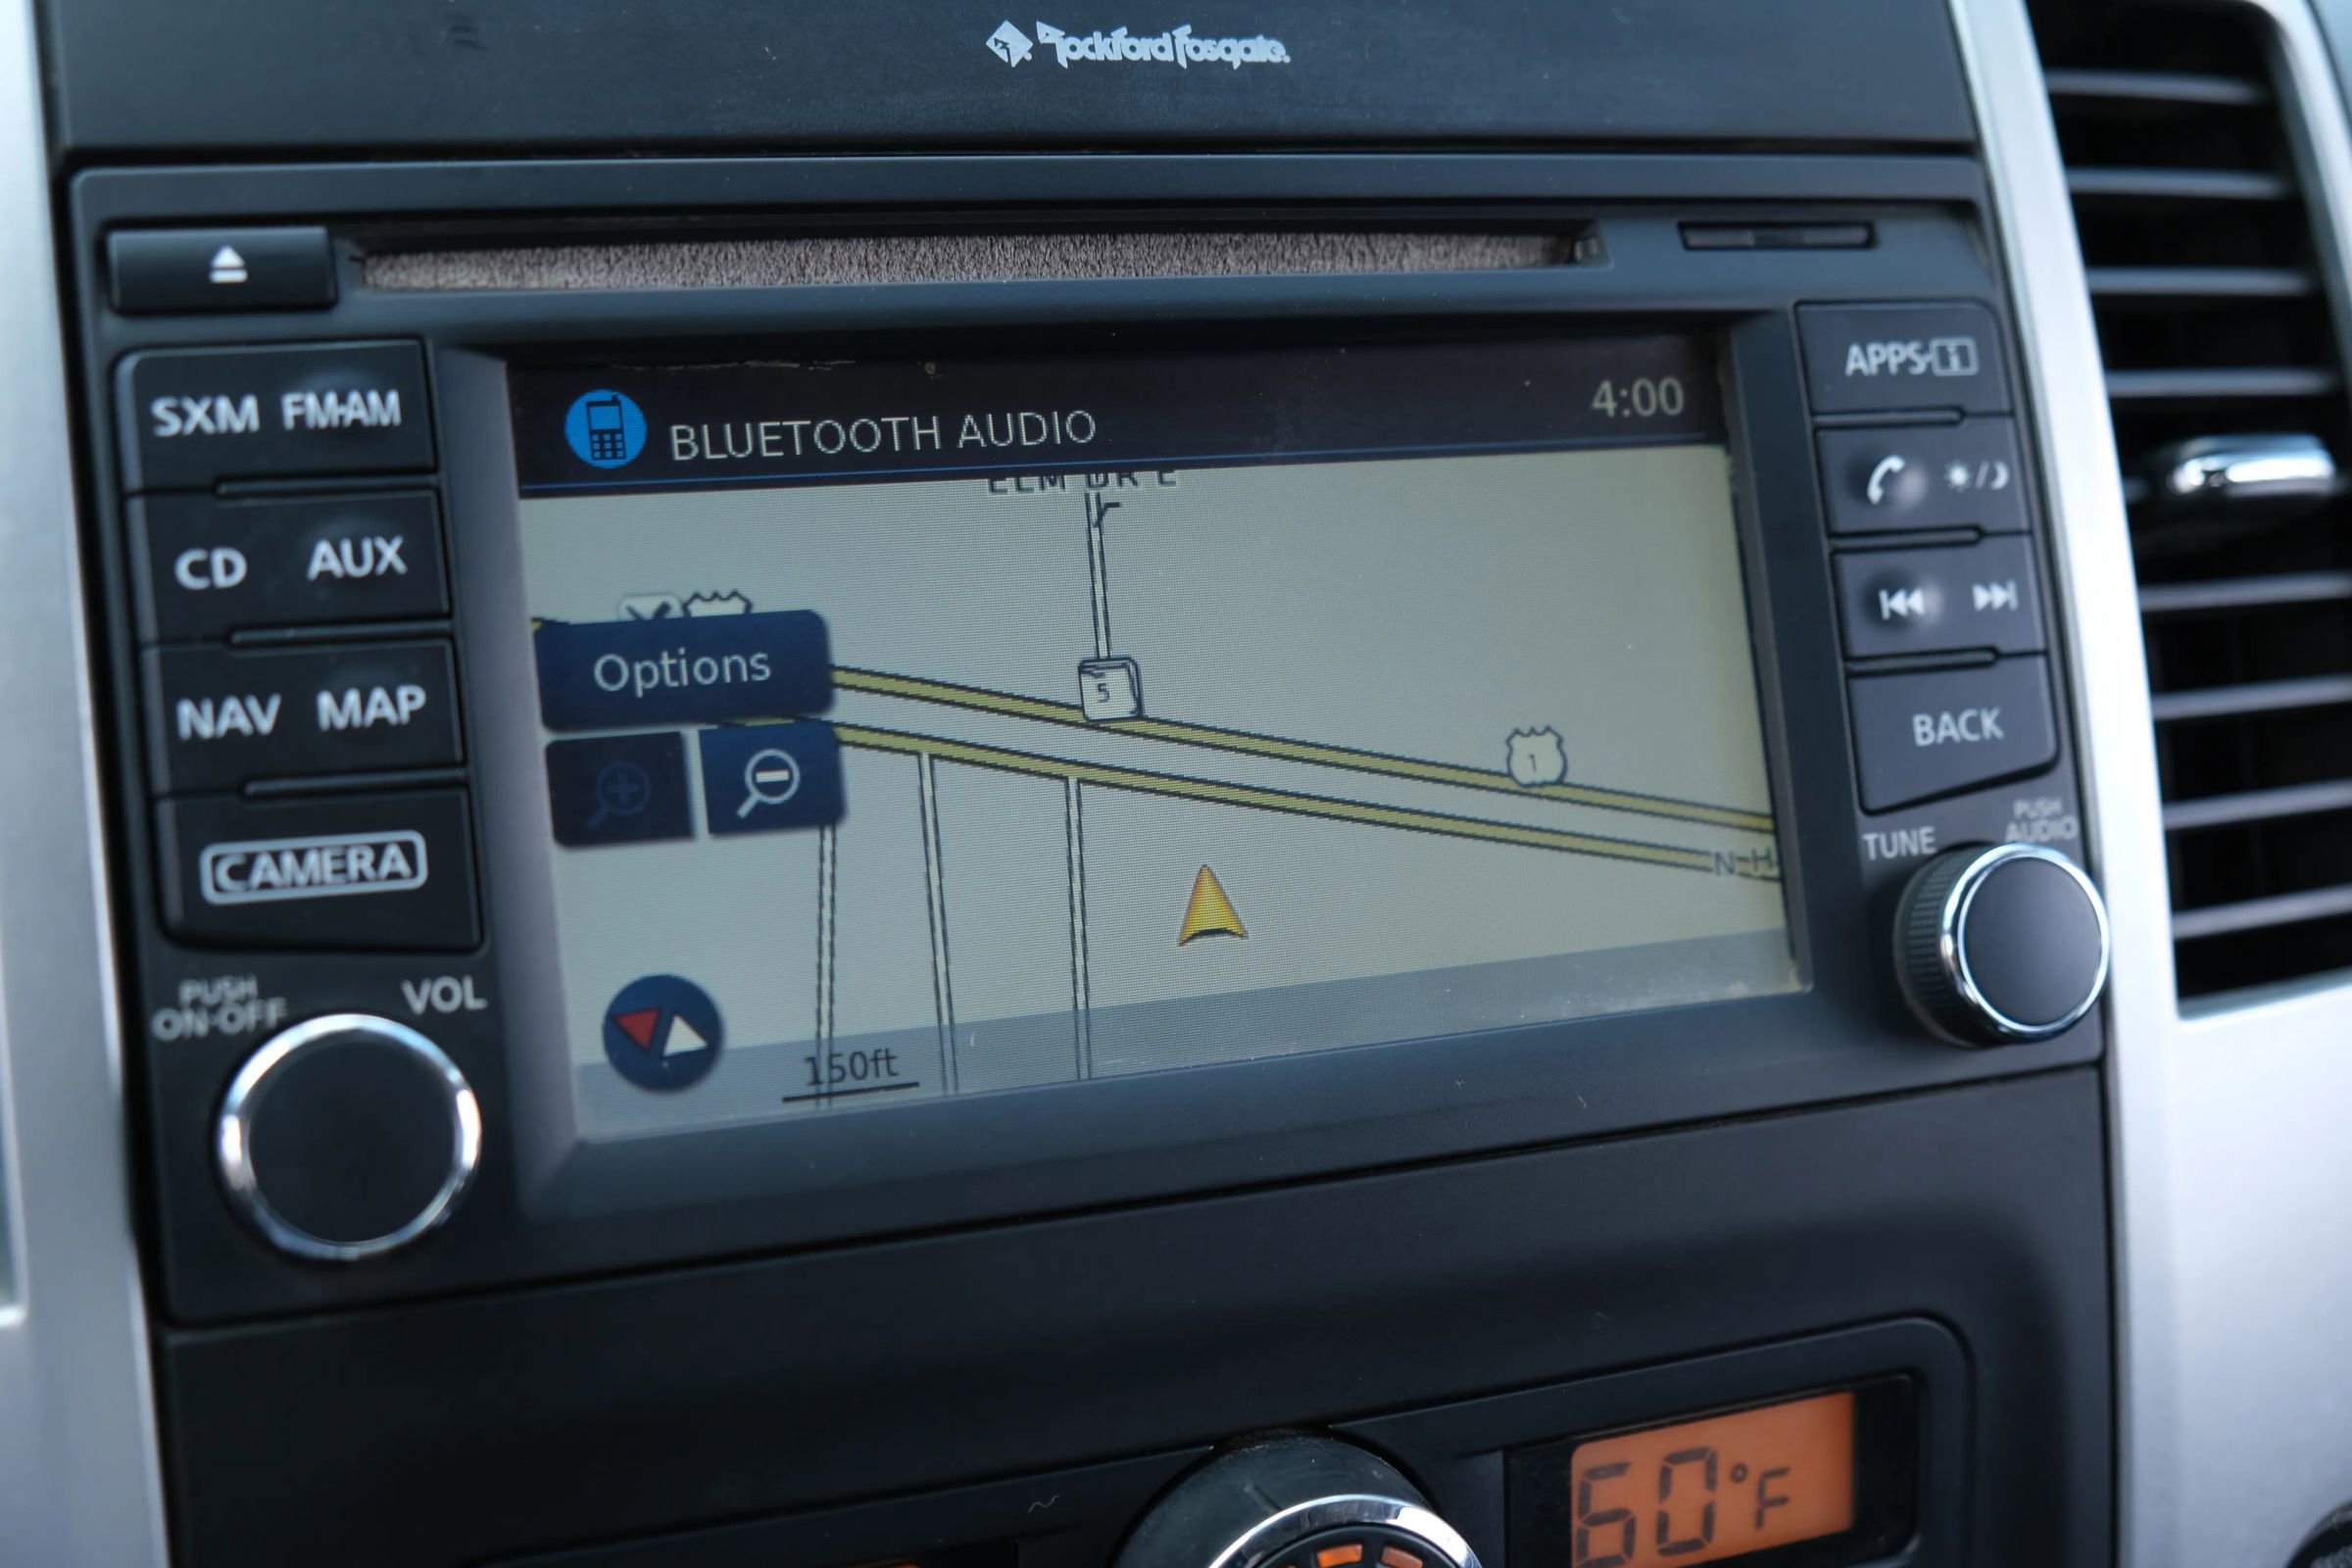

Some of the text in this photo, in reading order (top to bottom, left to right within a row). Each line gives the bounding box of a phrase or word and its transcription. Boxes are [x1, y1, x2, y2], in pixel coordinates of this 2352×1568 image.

[1036, 20, 1173, 69] Rockford
[150, 393, 261, 437] SXM
[1591, 377, 1685, 418] 4:00
[670, 409, 1098, 463] BLUETOOTH AUDIO
[174, 535, 409, 590] CD AUX
[593, 647, 772, 698] Options
[176, 684, 427, 741] NAV MAP
[1913, 708, 2005, 747] BACK
[2012, 797, 2063, 818] PUSH
[1864, 825, 1937, 861] TUNE
[2006, 814, 2079, 845] AUDIO
[214, 842, 414, 893] CAMERA
[178, 974, 259, 1007] PUSH
[402, 974, 488, 1015] VOL
[805, 1049, 901, 1087] 150ft
